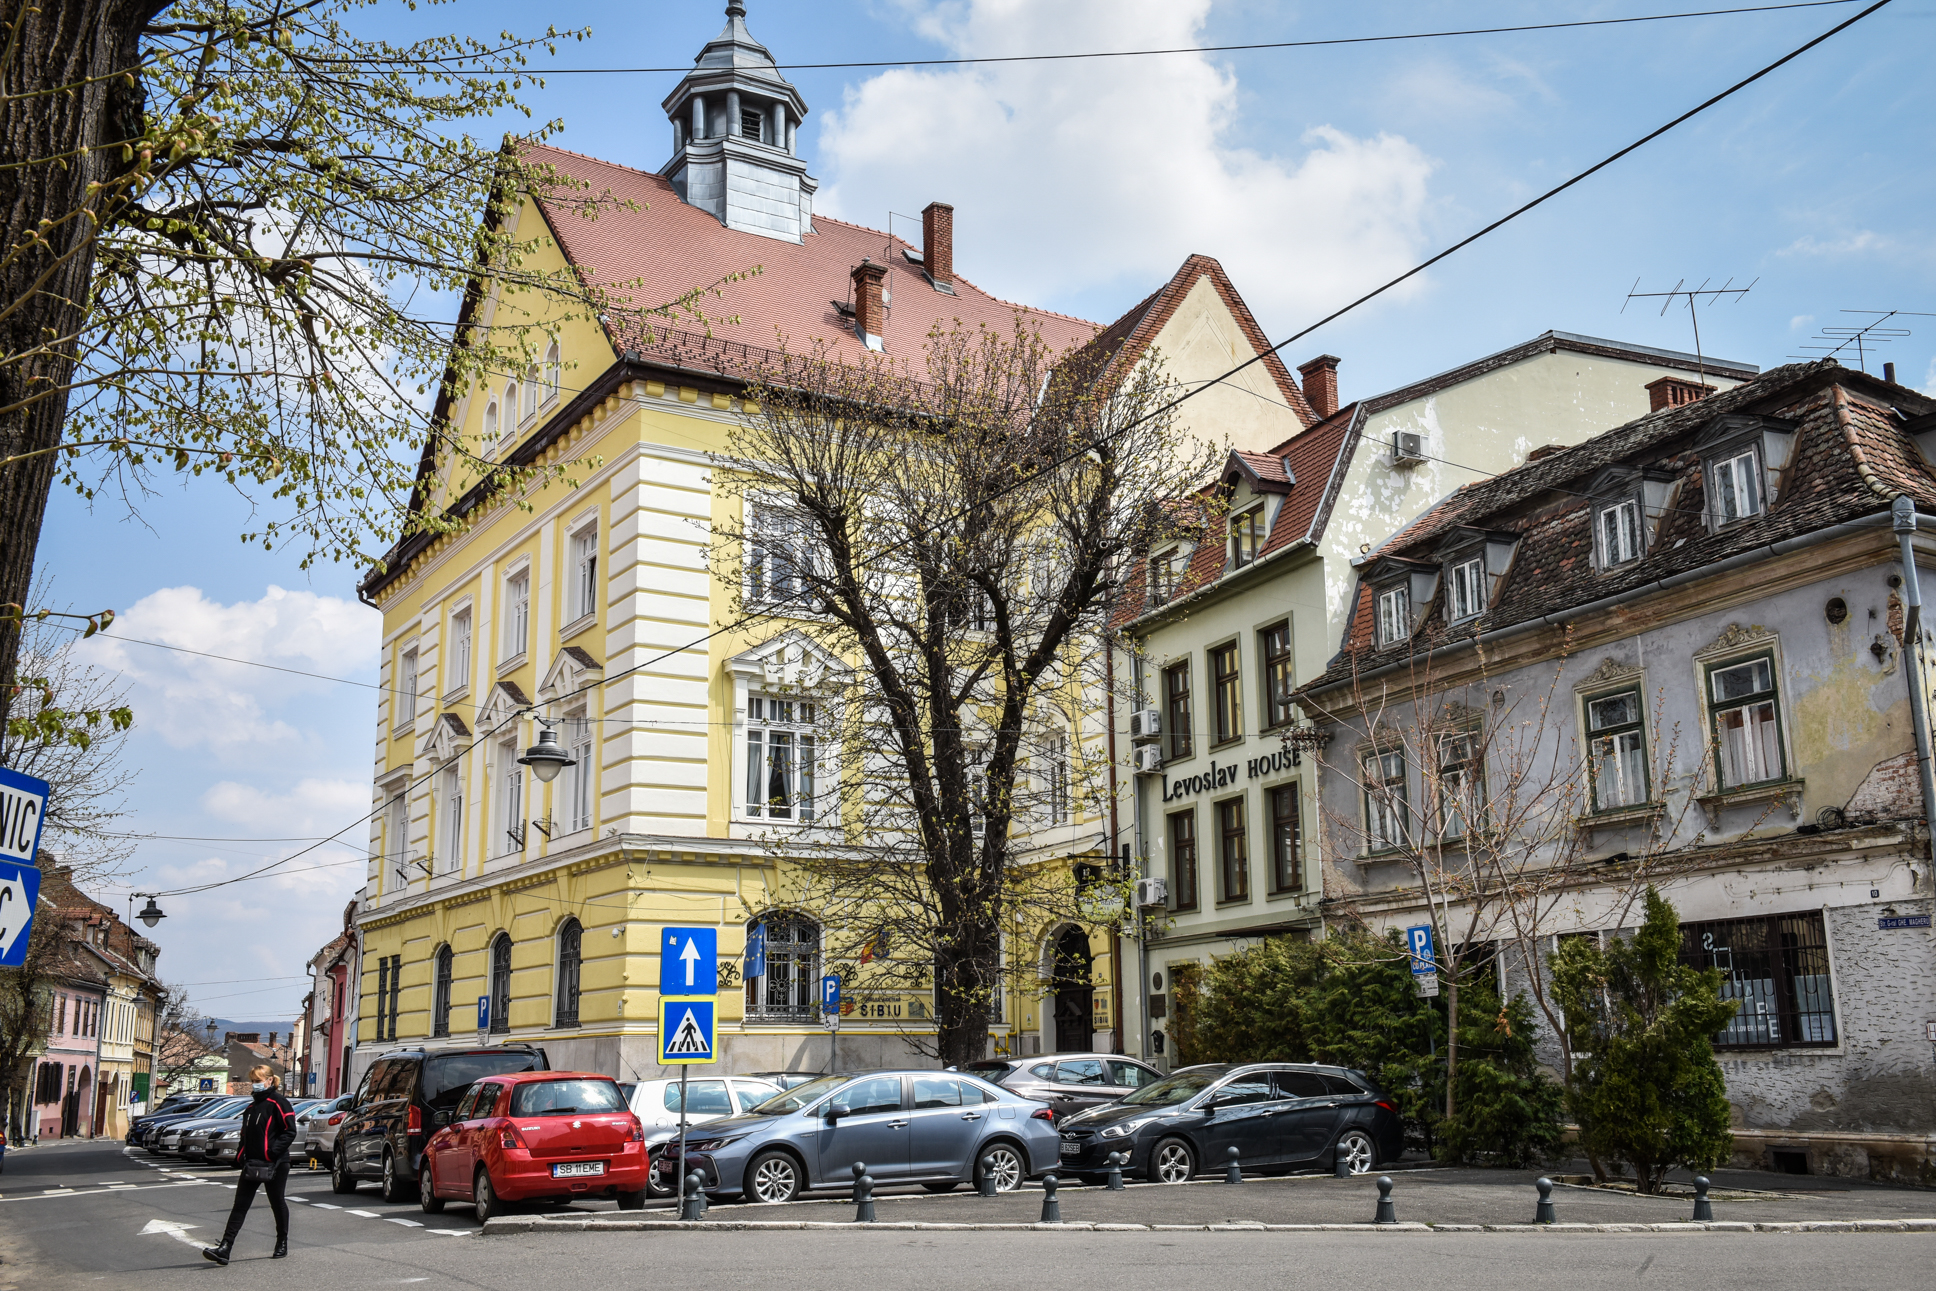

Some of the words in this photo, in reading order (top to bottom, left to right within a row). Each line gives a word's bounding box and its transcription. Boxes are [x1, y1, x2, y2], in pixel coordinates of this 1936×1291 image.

[1162, 761, 1238, 802] Levoslav
[1247, 749, 1301, 778] HOUSE
[826, 981, 836, 1002] P
[480, 998, 487, 1018] P
[861, 1004, 901, 1017] SIBIU
[560, 1164, 573, 1174] SB
